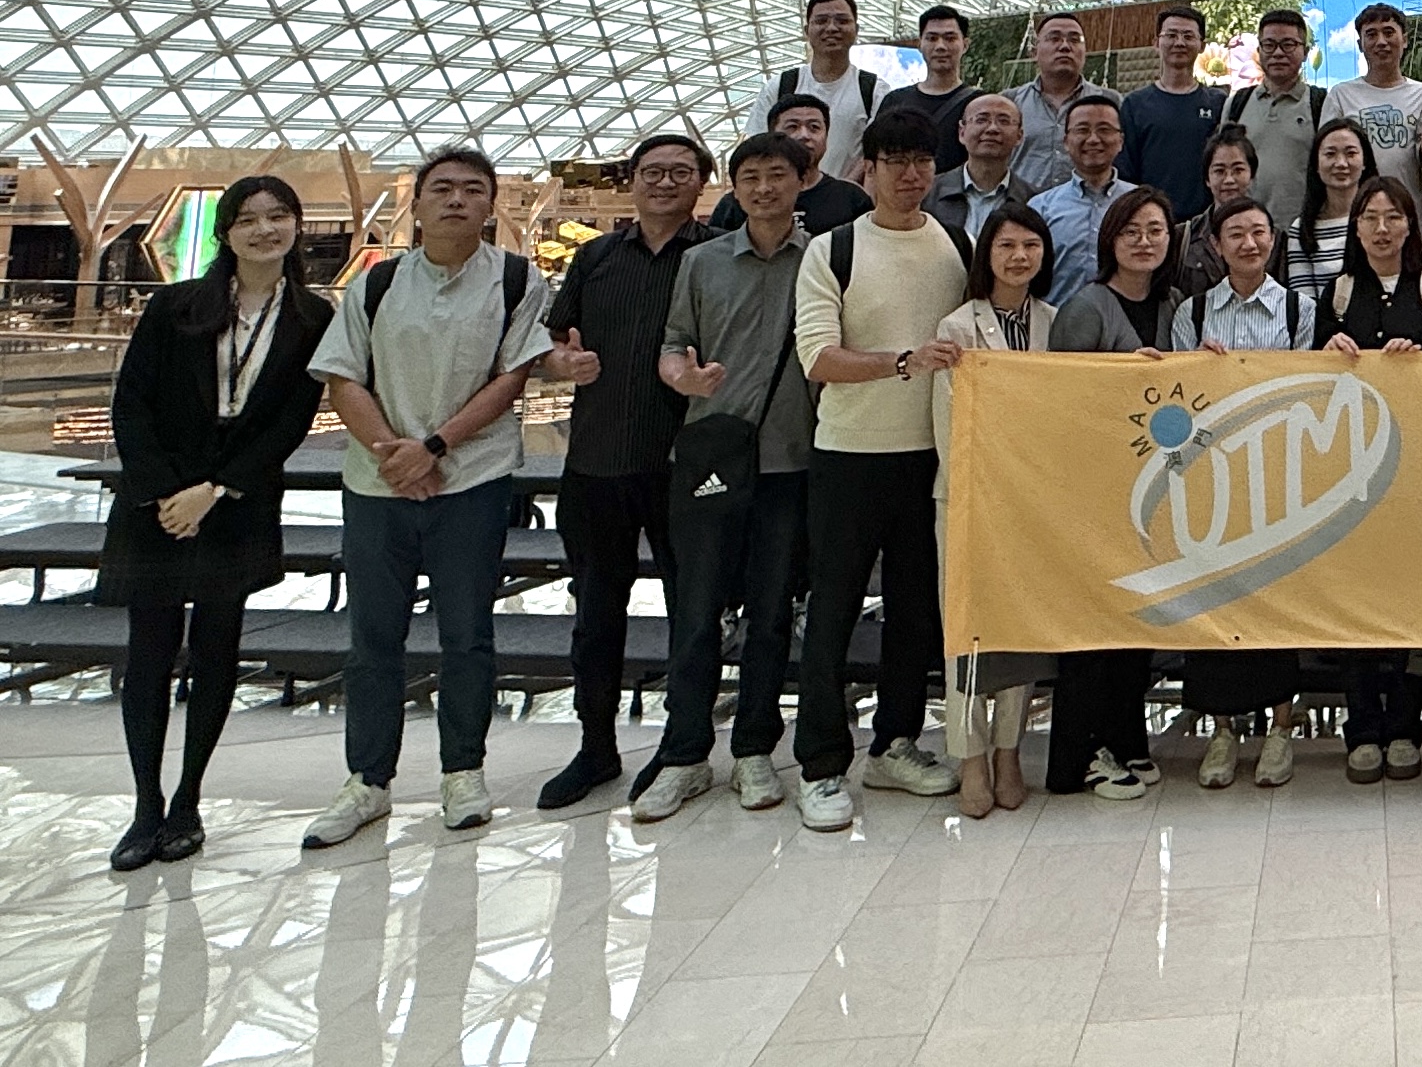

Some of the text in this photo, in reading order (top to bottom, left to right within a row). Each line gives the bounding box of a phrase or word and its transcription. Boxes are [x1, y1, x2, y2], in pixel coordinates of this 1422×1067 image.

[1359, 104, 1404, 130] Fun
[1367, 123, 1408, 149] Run
[1128, 382, 1210, 457] MACAU
